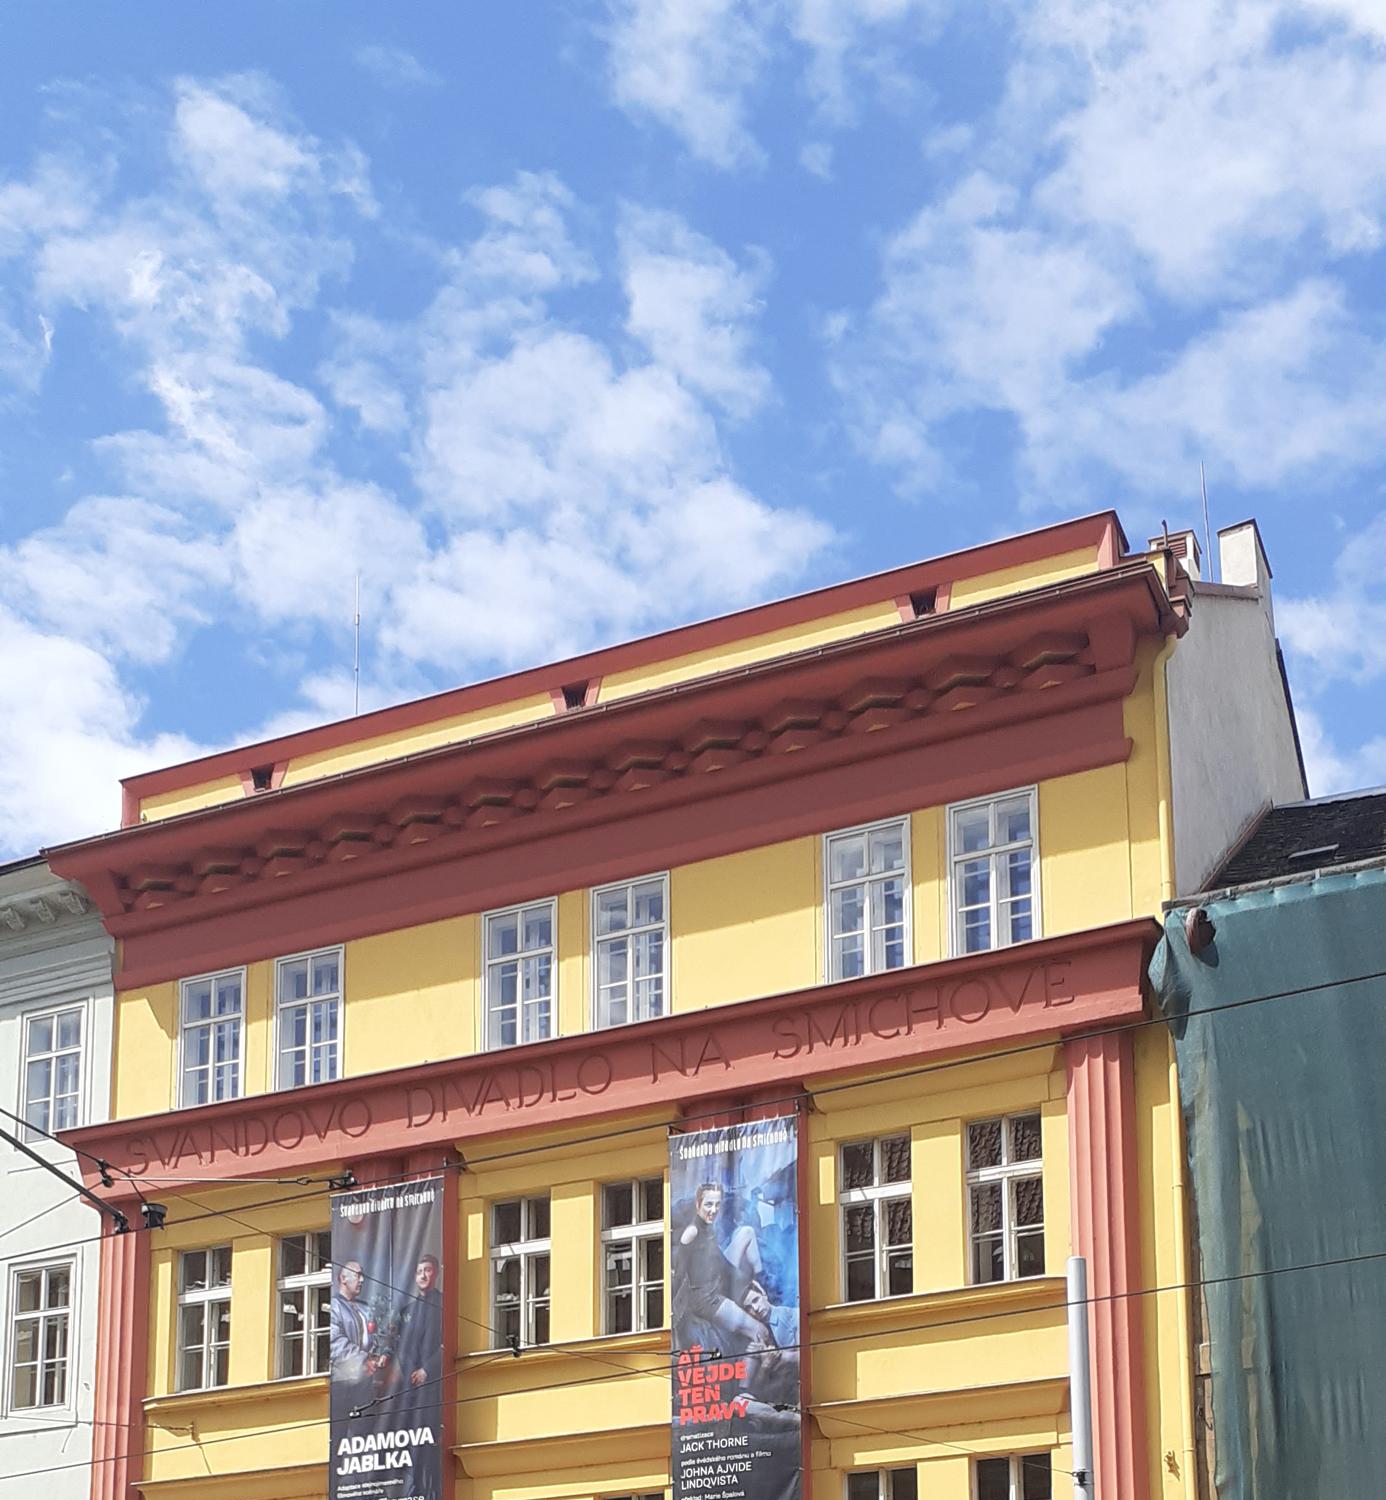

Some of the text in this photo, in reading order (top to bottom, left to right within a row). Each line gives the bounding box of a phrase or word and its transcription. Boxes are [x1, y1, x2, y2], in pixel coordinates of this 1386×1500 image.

[405, 1054, 613, 1128] DIVADLO
[650, 1031, 735, 1084] NA
[678, 1361, 748, 1387] VEJDE
[680, 1400, 749, 1425] PRAVÝ
[337, 1427, 435, 1456] ADAMOVA
[680, 1436, 749, 1454] JACK THORNE
[336, 1450, 413, 1476] JABLKA
[680, 1461, 752, 1479] JOHNA AJVIDE
[681, 1474, 739, 1490] LINDQVISTA
